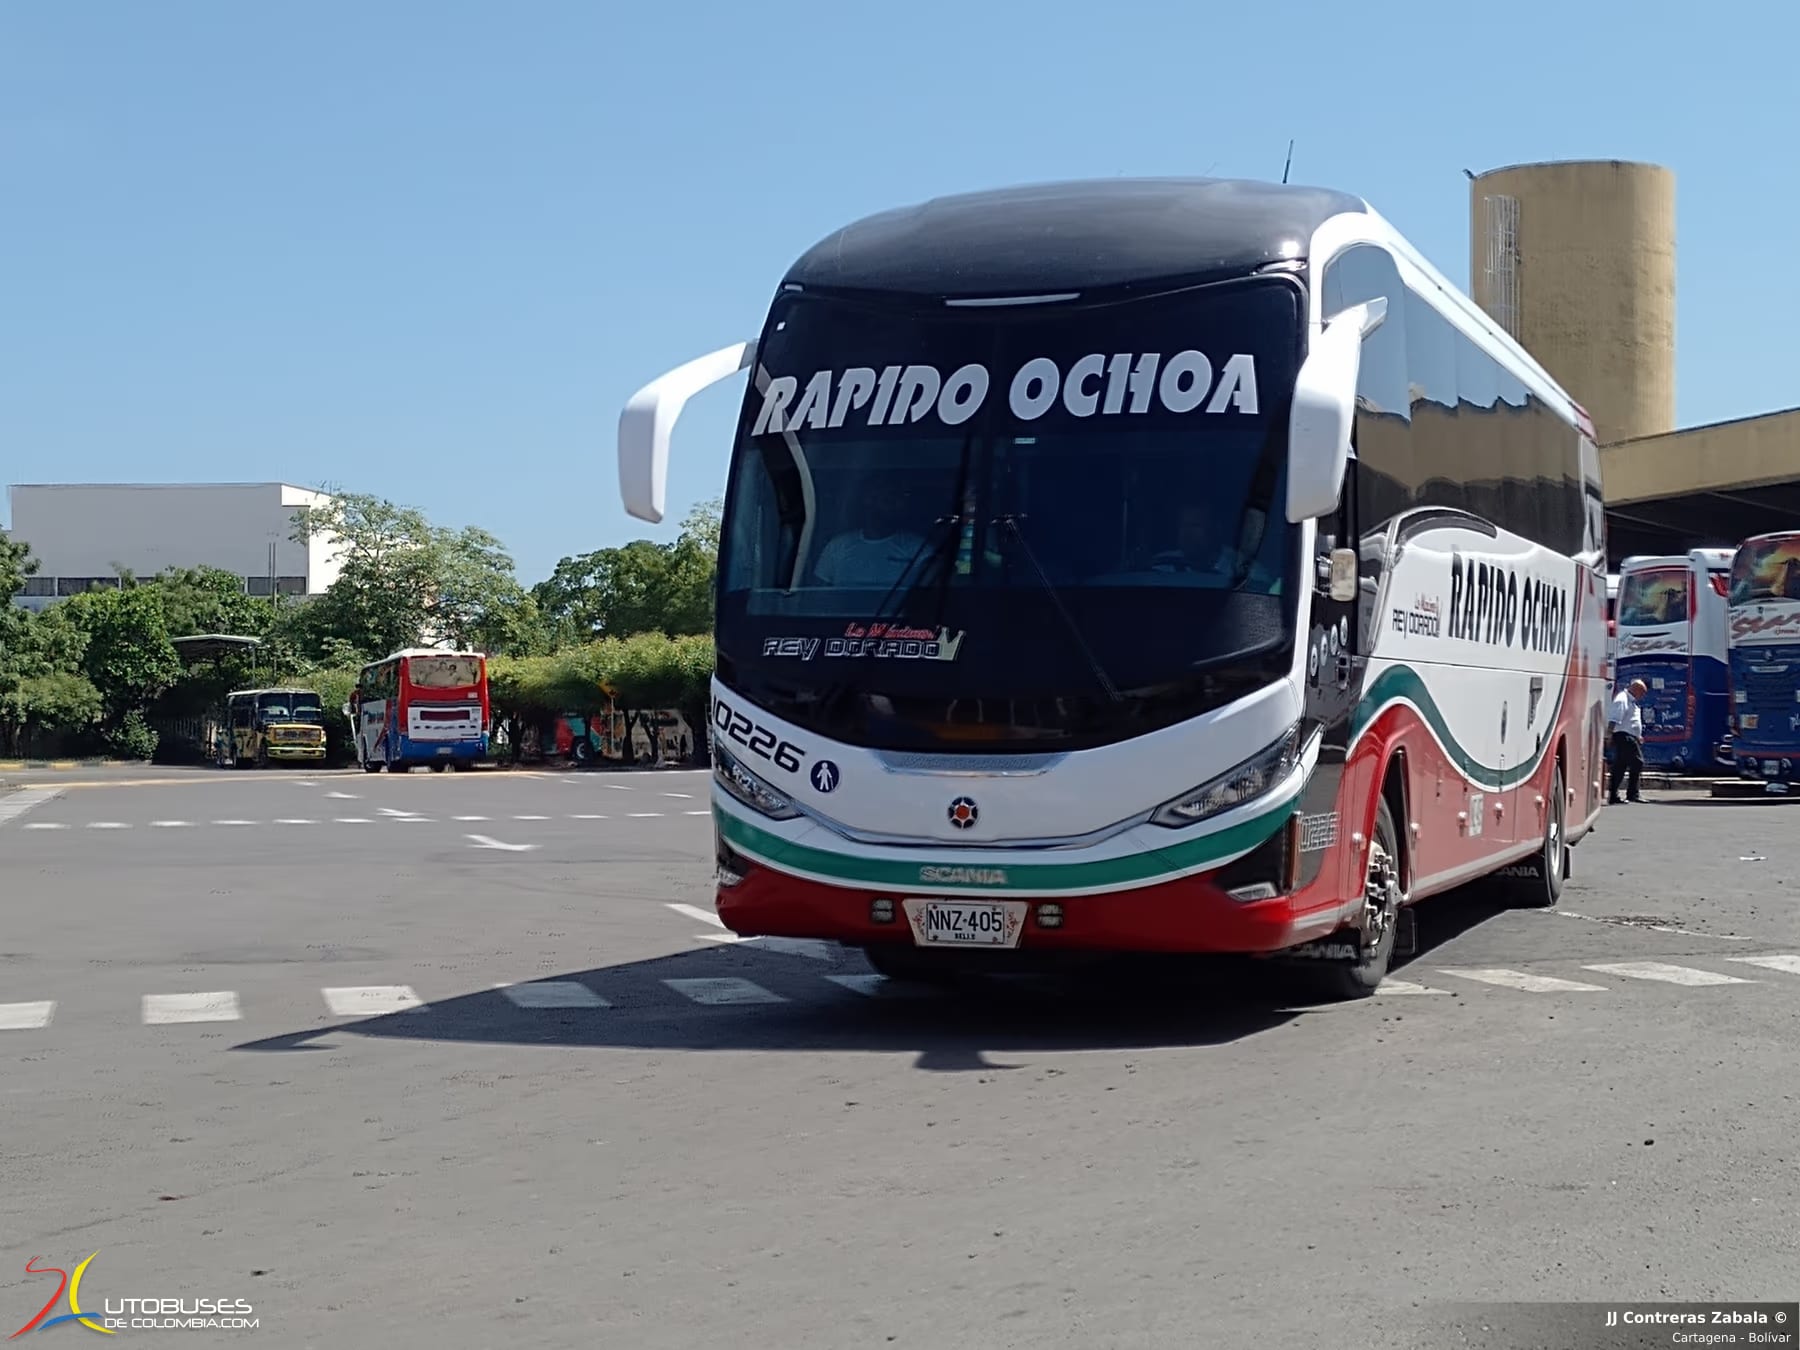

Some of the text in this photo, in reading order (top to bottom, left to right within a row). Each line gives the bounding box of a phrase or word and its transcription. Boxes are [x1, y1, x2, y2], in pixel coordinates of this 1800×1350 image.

[751, 350, 1260, 436] RAPIDO OCHOA
[1448, 552, 1566, 655] RAPIDO OCHOA
[763, 637, 942, 661] REY DORADO
[920, 866, 1008, 885] SCANIA
